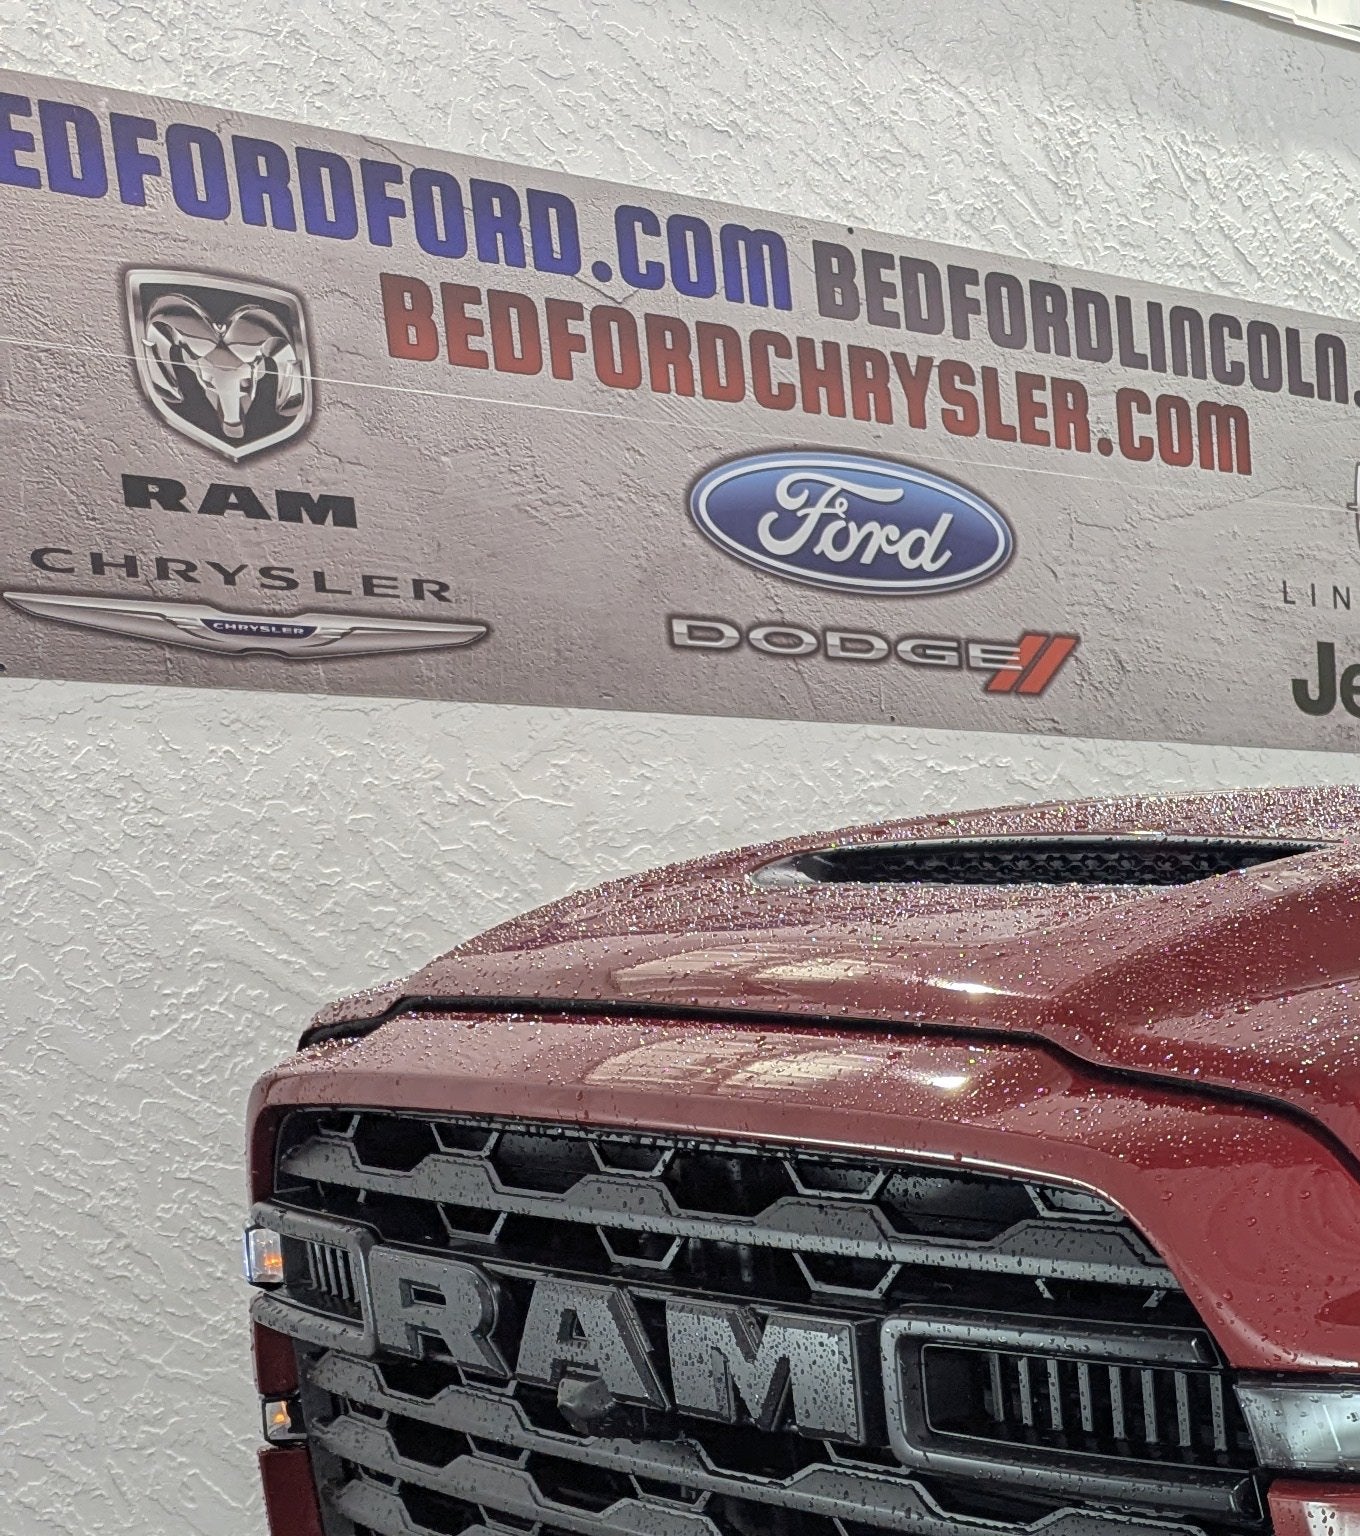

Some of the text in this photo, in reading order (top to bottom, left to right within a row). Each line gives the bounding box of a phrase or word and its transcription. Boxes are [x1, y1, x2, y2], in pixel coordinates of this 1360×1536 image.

[380, 272, 1252, 476] BEDFORDCHRYSLER.COM
[120, 473, 358, 530] RAM
[757, 471, 953, 573] Ford
[30, 547, 452, 602] CHRYSLER
[212, 622, 305, 635] CHRYSLER
[672, 616, 1026, 672] DODGE
[370, 1243, 878, 1447] RAM
